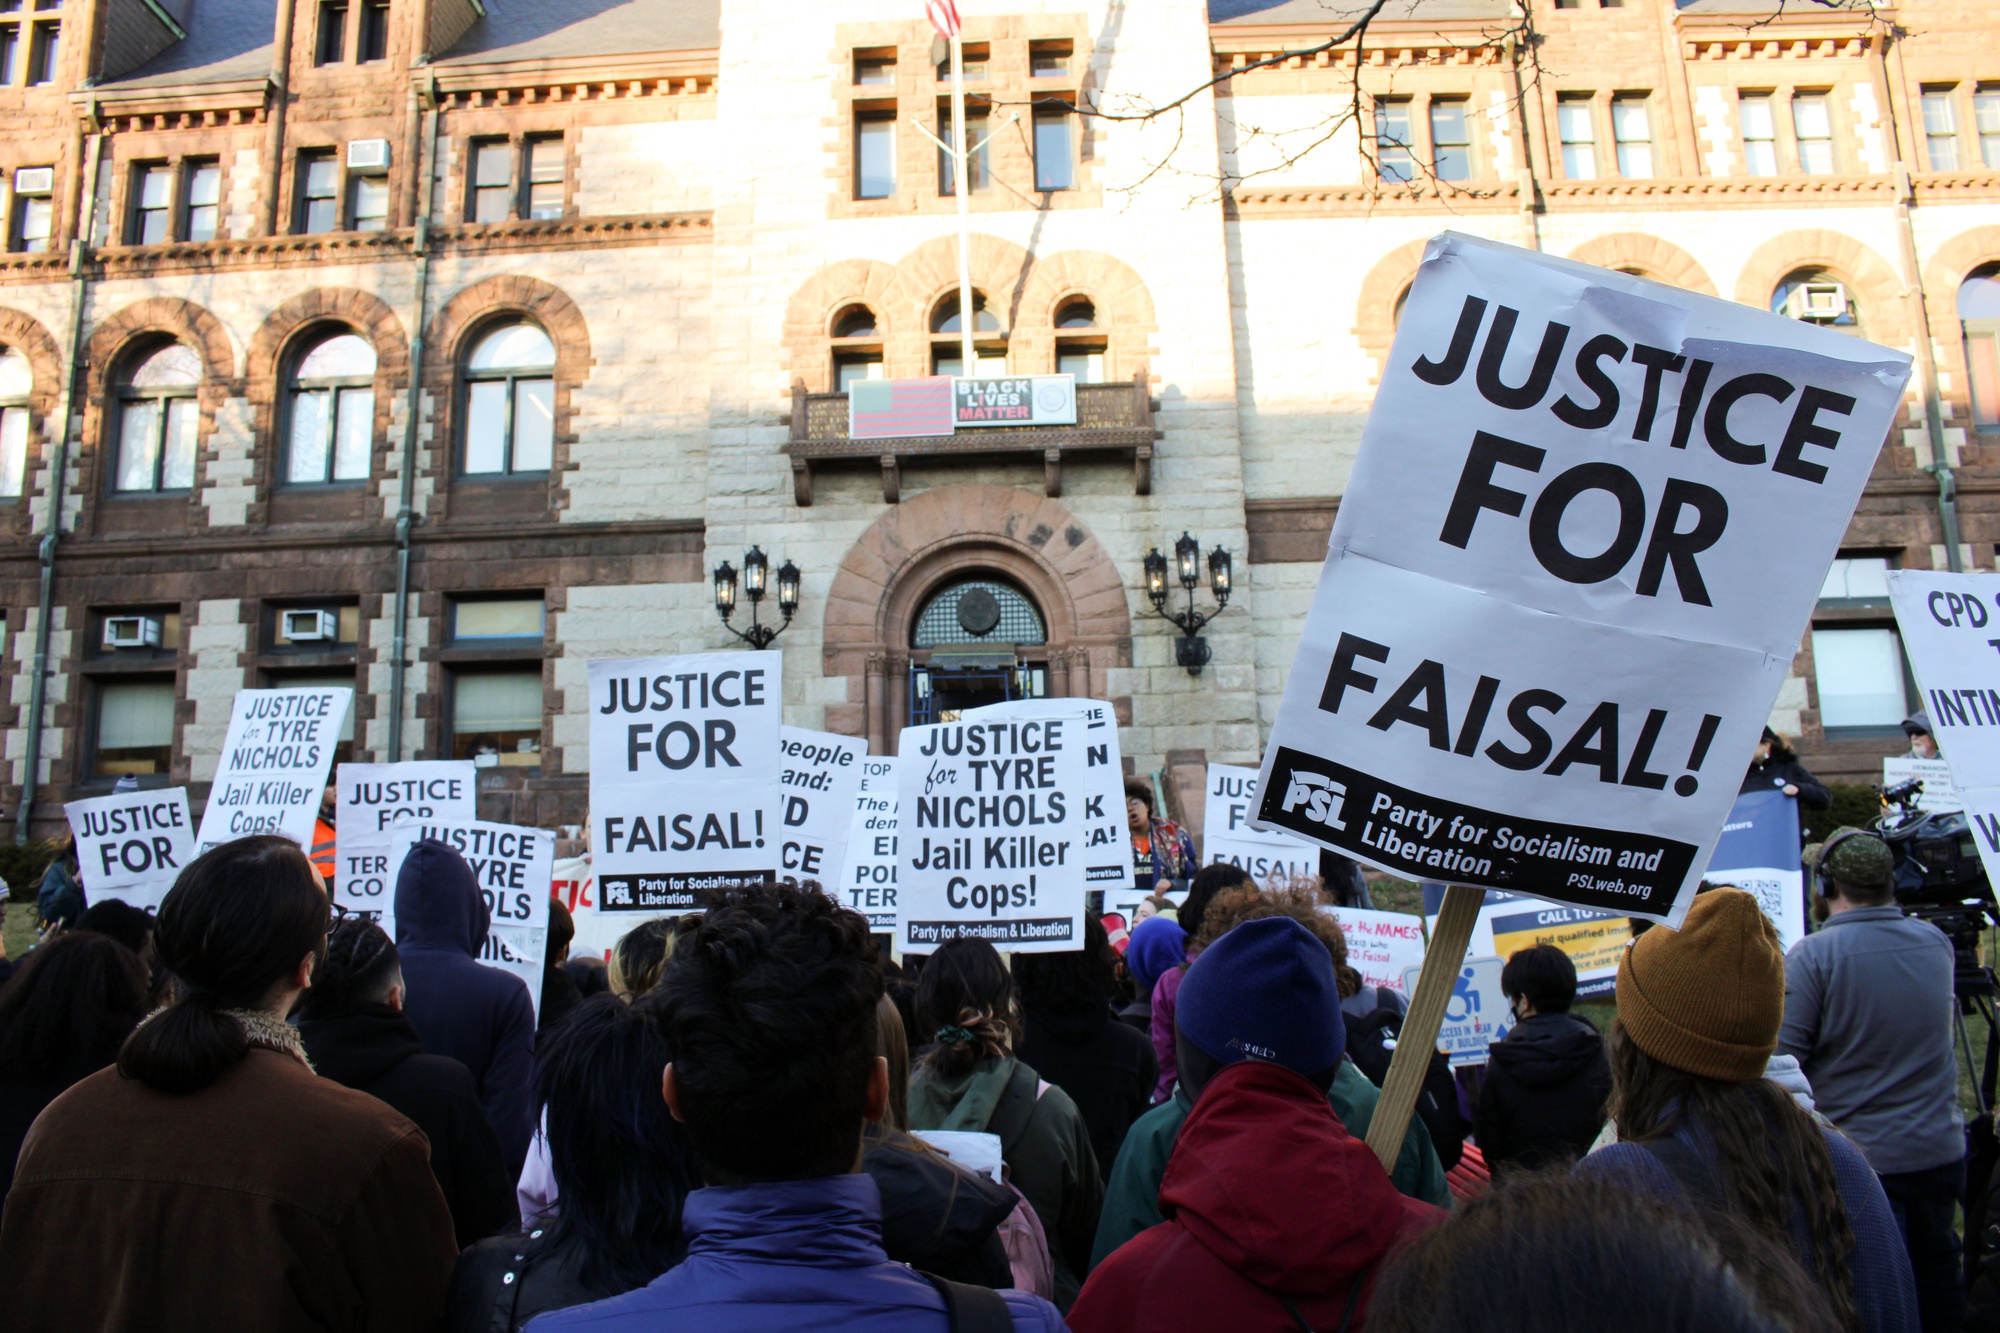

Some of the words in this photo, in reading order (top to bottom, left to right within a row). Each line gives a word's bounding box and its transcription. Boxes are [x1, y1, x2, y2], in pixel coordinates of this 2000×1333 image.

[958, 380, 1029, 395] BLACK
[967, 393, 1020, 407] LIVES
[1411, 294, 1857, 485] JUSTICE
[959, 405, 1029, 420] MATTER
[1438, 430, 1729, 608] FOR
[1927, 590, 1989, 628] CPD
[599, 669, 766, 715] JUSTICE
[245, 694, 334, 720] JUSTICE
[1318, 631, 1722, 799] FAISAL!
[239, 721, 261, 748] for
[266, 719, 321, 743] TYRE
[627, 718, 743, 772] FOR
[919, 720, 1063, 757] JUSTICE
[229, 744, 321, 772] NICHOLS
[924, 758, 959, 796] for
[967, 755, 1056, 792] TYRE
[217, 781, 254, 806] Jail
[256, 781, 314, 805] Killer
[348, 778, 462, 805] JUSTICE
[856, 797, 888, 811] The
[1281, 778, 1346, 832] PSL
[81, 802, 183, 838] JUSTICE
[229, 809, 286, 835] Cops!
[916, 790, 1067, 829] NICHOLS
[604, 809, 766, 854] FAISAL!
[1371, 790, 1443, 840] Party
[1449, 814, 1490, 845] for
[1492, 825, 1613, 867] Socialism
[1616, 848, 1665, 874] and
[99, 836, 180, 877] FOR
[911, 837, 980, 870] Jail
[984, 834, 1070, 870] Killer
[1361, 820, 1492, 877] Liberation
[466, 857, 526, 890] YRE
[638, 878, 667, 894] Party
[669, 877, 685, 890] for
[687, 876, 742, 890] Socialism
[1566, 872, 1653, 901] PSLweb.org
[638, 892, 694, 906] Liberation
[946, 873, 1037, 917] Cops!
[910, 924, 939, 942] Party
[940, 925, 957, 939] for
[958, 923, 1008, 939] Socialism
[1009, 923, 1019, 938] &
[1020, 921, 1071, 938] Liberation
[1358, 921, 1373, 935] the
[1375, 923, 1419, 941] NAMES
[1537, 911, 1572, 925] CALL
[1370, 940, 1389, 950] who
[1535, 936, 1555, 945] End
[1557, 928, 1604, 944] qualified
[1438, 1026, 1463, 1039] ACCESS
[1464, 1025, 1472, 1036] IN
[1475, 1022, 1493, 1034] REAR
[1446, 1039, 1454, 1050] OF
[1457, 1035, 1489, 1049] BUILDING
